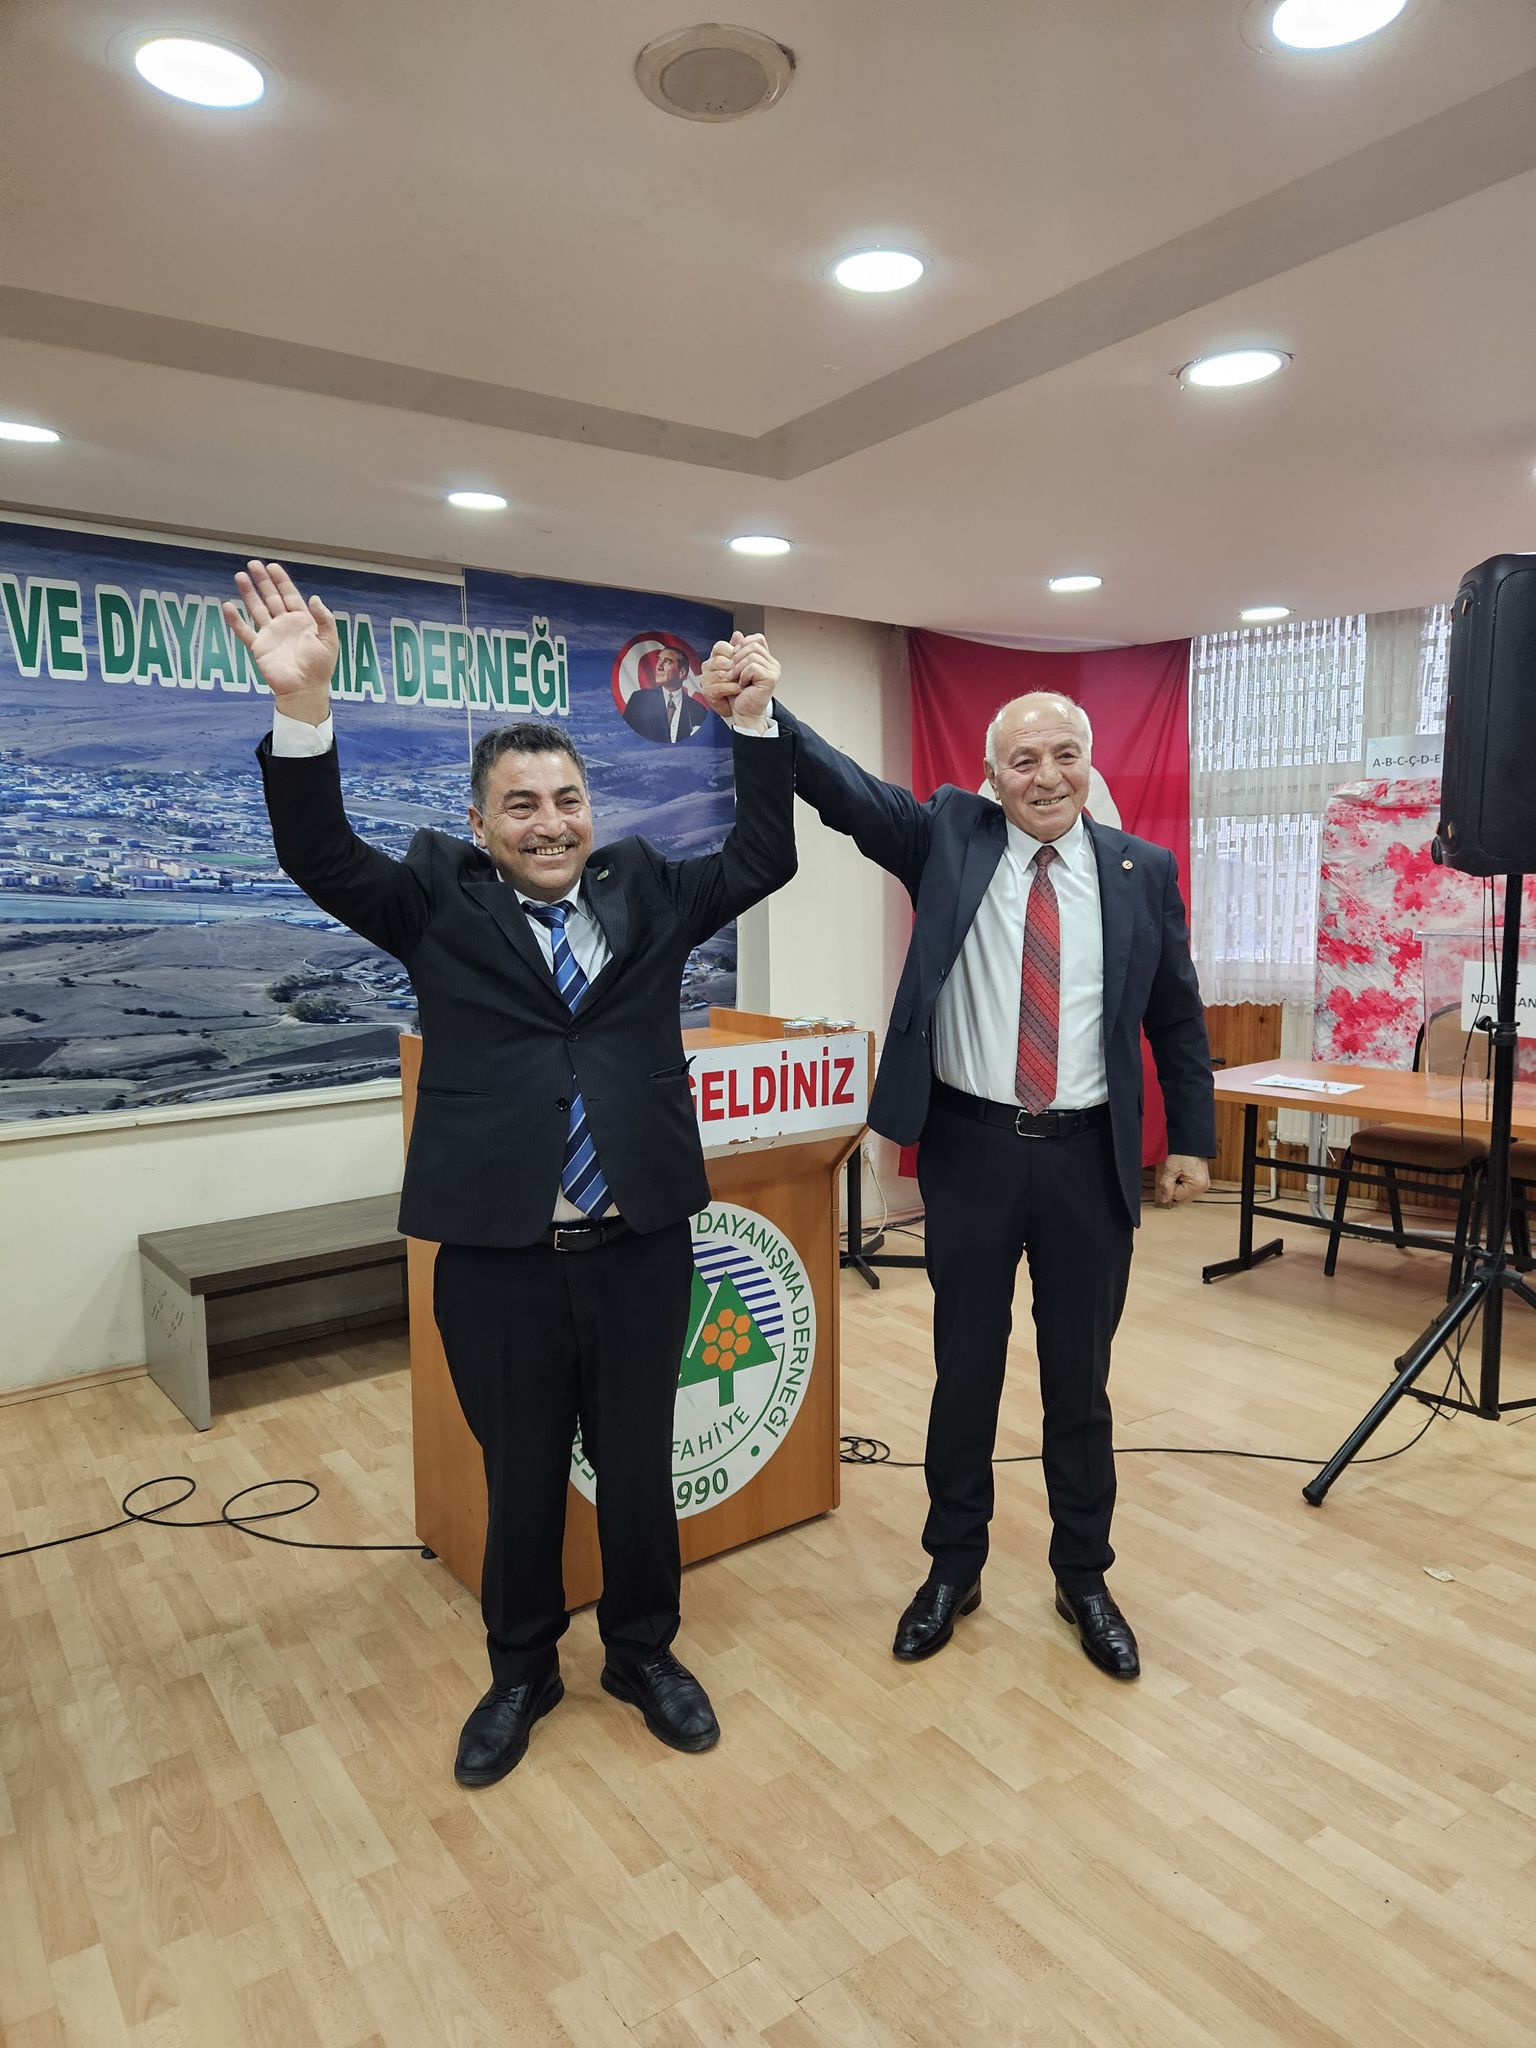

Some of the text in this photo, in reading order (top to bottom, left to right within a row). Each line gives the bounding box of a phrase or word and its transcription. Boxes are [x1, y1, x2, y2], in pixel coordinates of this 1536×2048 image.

[0, 574, 569, 715] VE DAYANA DERNEĞİ
[688, 1046, 855, 1122] ELDİNİZ
[696, 1211, 810, 1439] DAYANIŞMA DERNEĞİ
